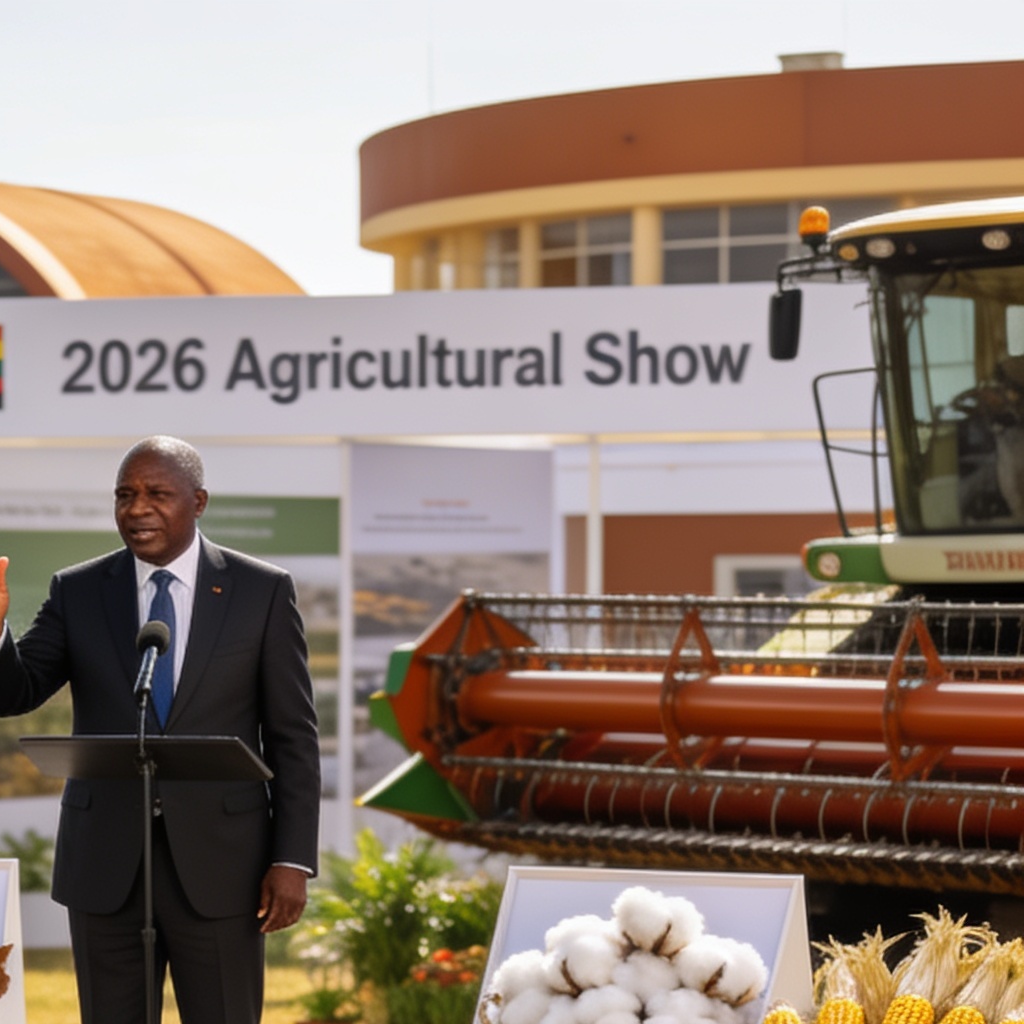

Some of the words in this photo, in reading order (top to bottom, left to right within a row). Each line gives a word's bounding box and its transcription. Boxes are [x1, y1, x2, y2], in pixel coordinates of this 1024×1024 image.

[61, 338, 206, 394] 2026
[224, 331, 563, 405] Agricultural
[583, 330, 751, 386] Show
